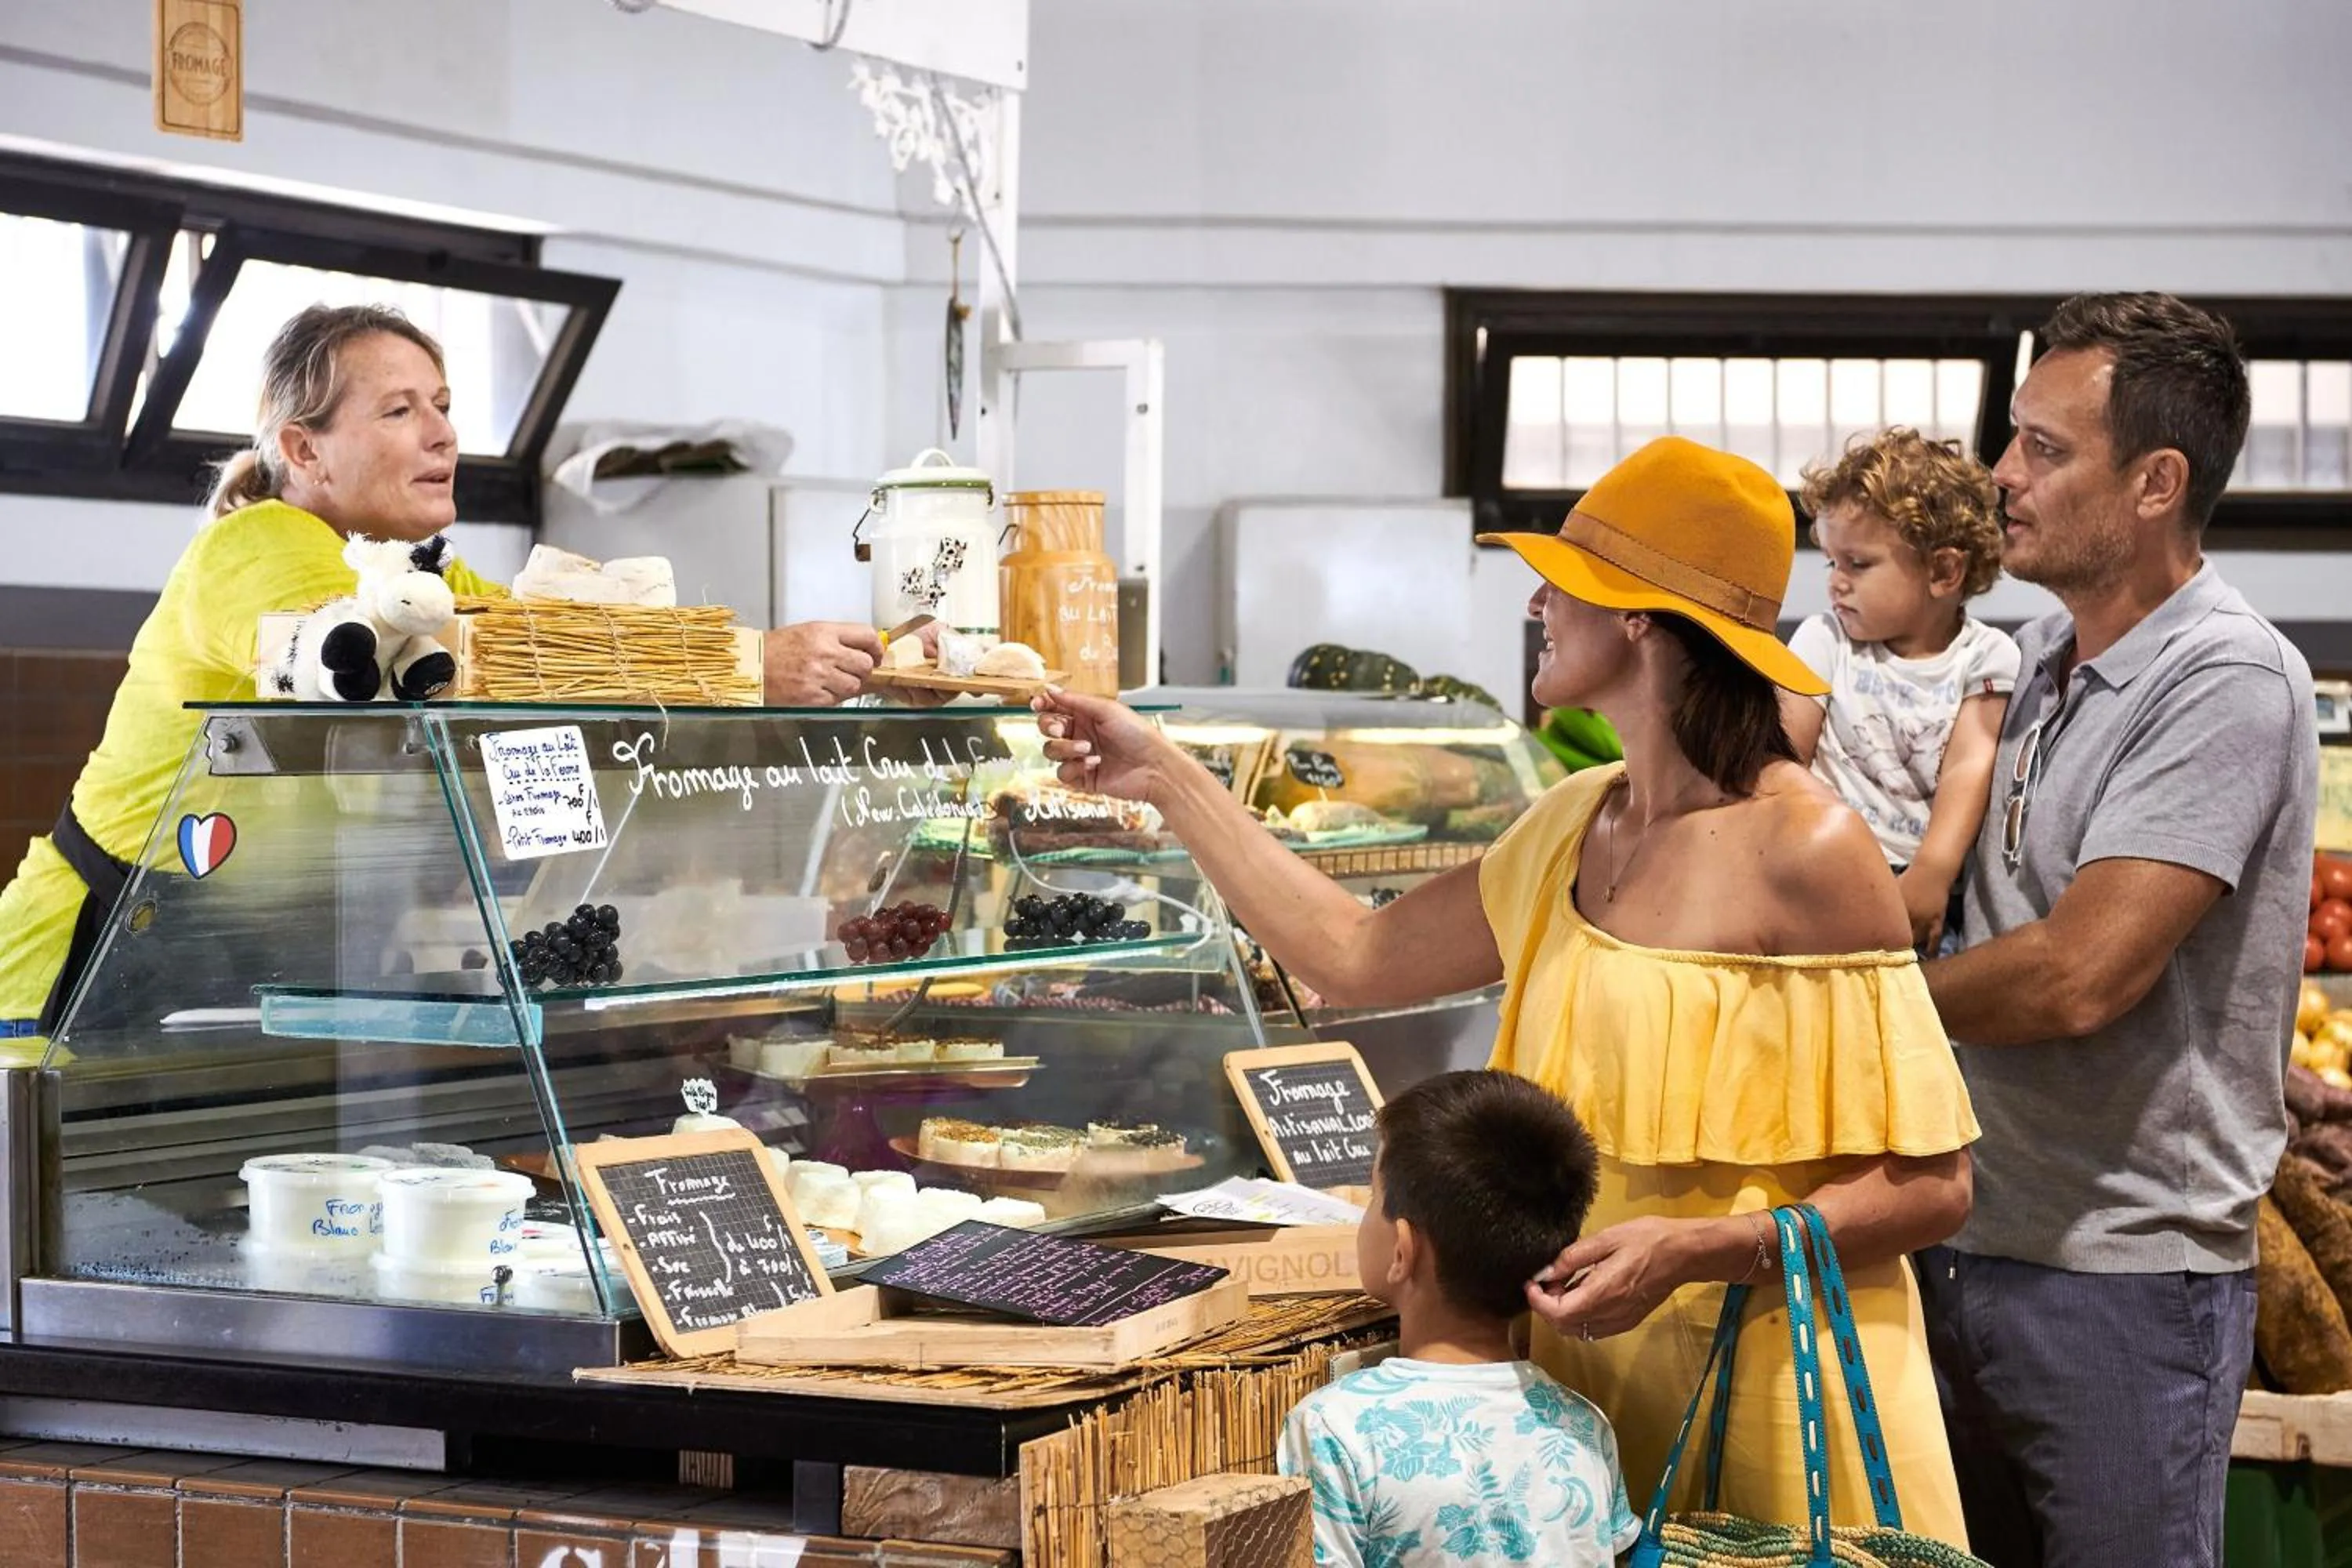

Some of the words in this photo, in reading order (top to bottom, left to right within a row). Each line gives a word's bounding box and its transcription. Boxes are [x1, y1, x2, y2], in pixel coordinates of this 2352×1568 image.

[172, 51, 227, 78] FROMAGE
[612, 731, 760, 811] Fromage
[766, 764, 802, 788] au
[799, 736, 860, 785] lait
[864, 735, 917, 779] Cru
[1259, 1069, 1351, 1115] Fromage
[644, 1167, 731, 1195] Fromage
[1205, 1250, 1354, 1282] VIGNOL
